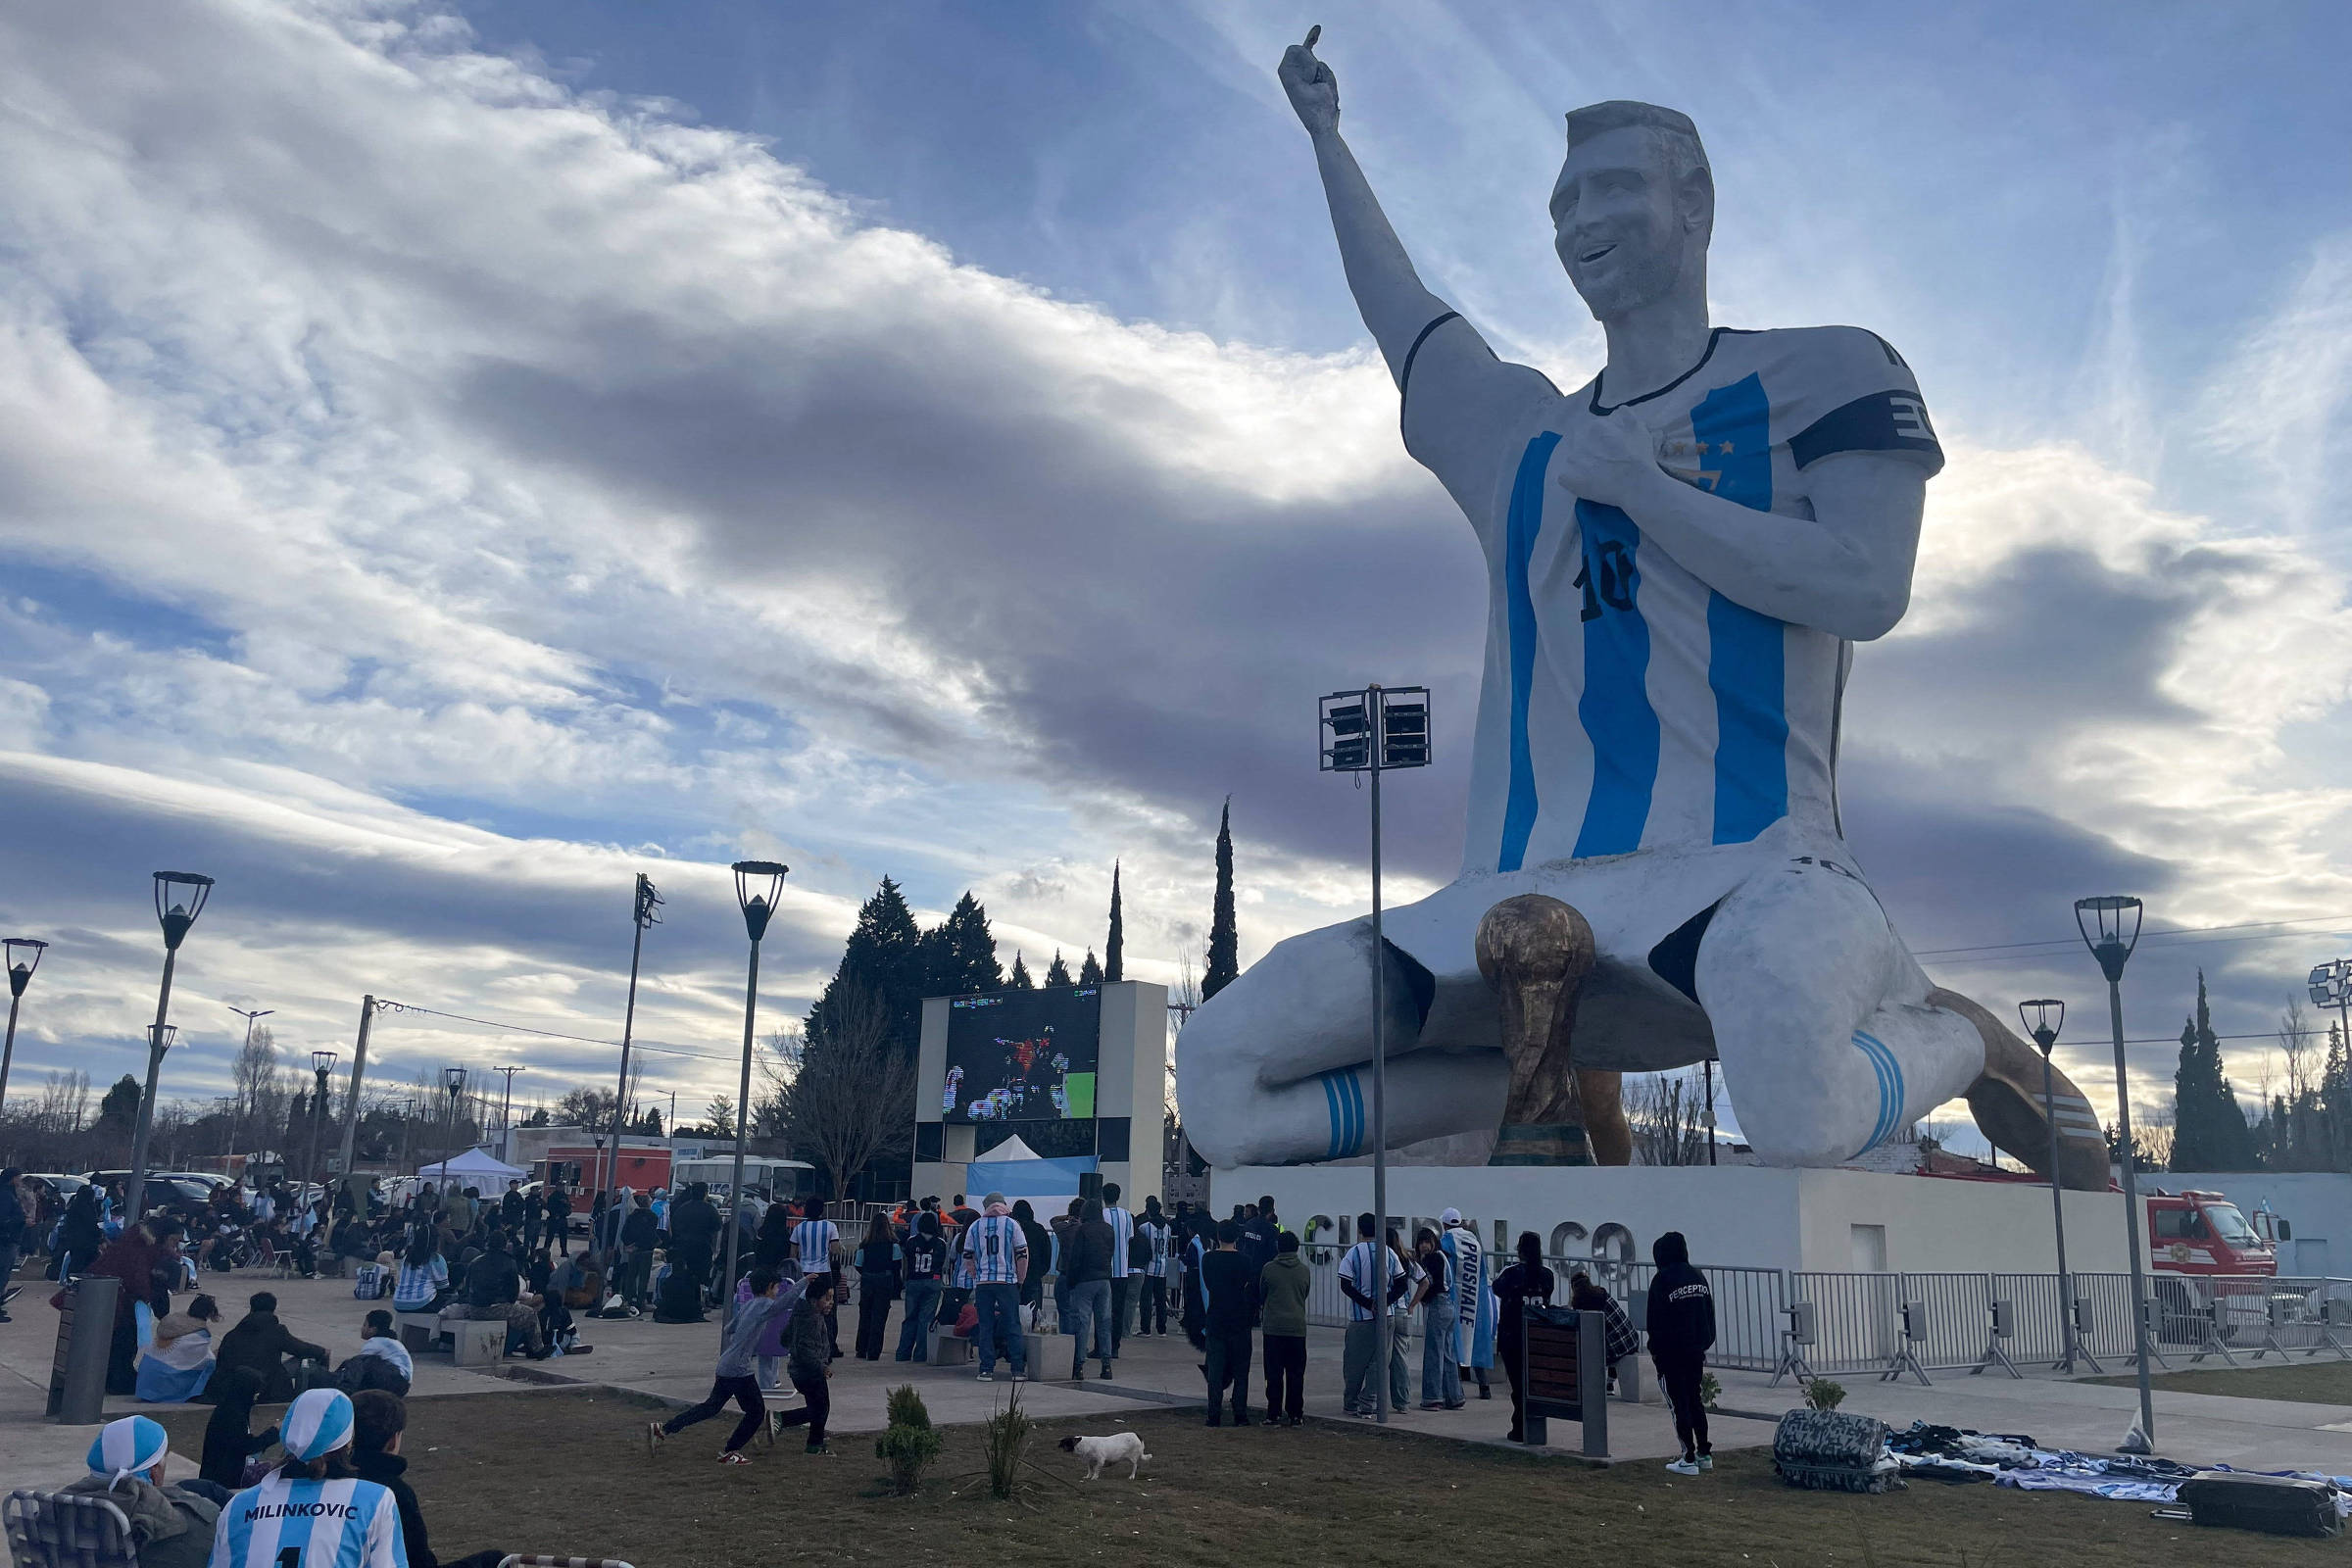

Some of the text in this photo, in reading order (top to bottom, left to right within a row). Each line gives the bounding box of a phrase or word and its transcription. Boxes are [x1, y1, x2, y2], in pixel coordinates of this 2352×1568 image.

[1573, 540, 1635, 623] 10
[985, 1235, 1000, 1255] 10
[914, 1253, 933, 1273] 10
[244, 1502, 359, 1523] MILINKOVIC
